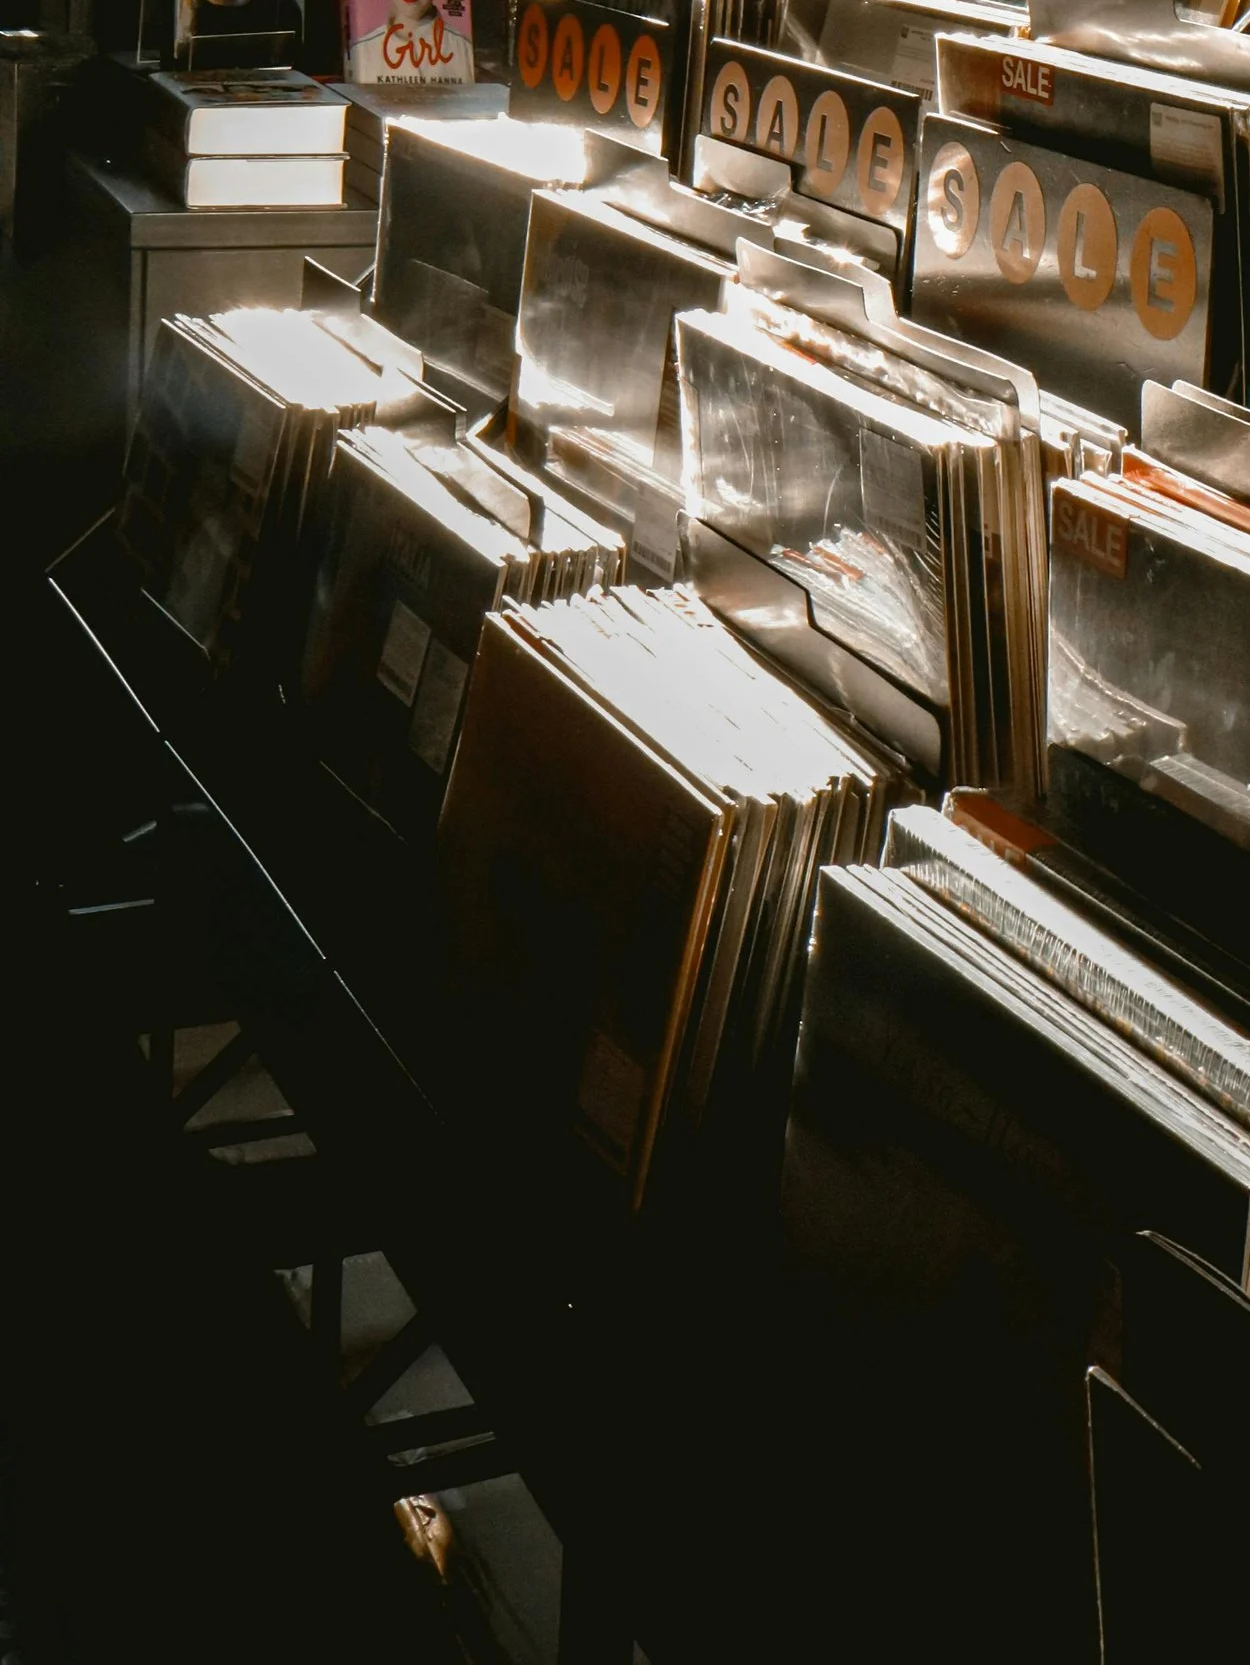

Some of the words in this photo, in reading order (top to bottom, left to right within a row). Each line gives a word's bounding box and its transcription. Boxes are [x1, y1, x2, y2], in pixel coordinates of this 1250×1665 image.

[383, 17, 454, 69] Girl
[523, 15, 653, 109] SALE
[377, 75, 426, 85] KATHLEEN
[430, 77, 463, 86] HANNA
[1001, 56, 1051, 99] SALE
[718, 82, 894, 194] SALE
[939, 167, 1178, 314] SALE
[1058, 501, 1122, 568] SALE
